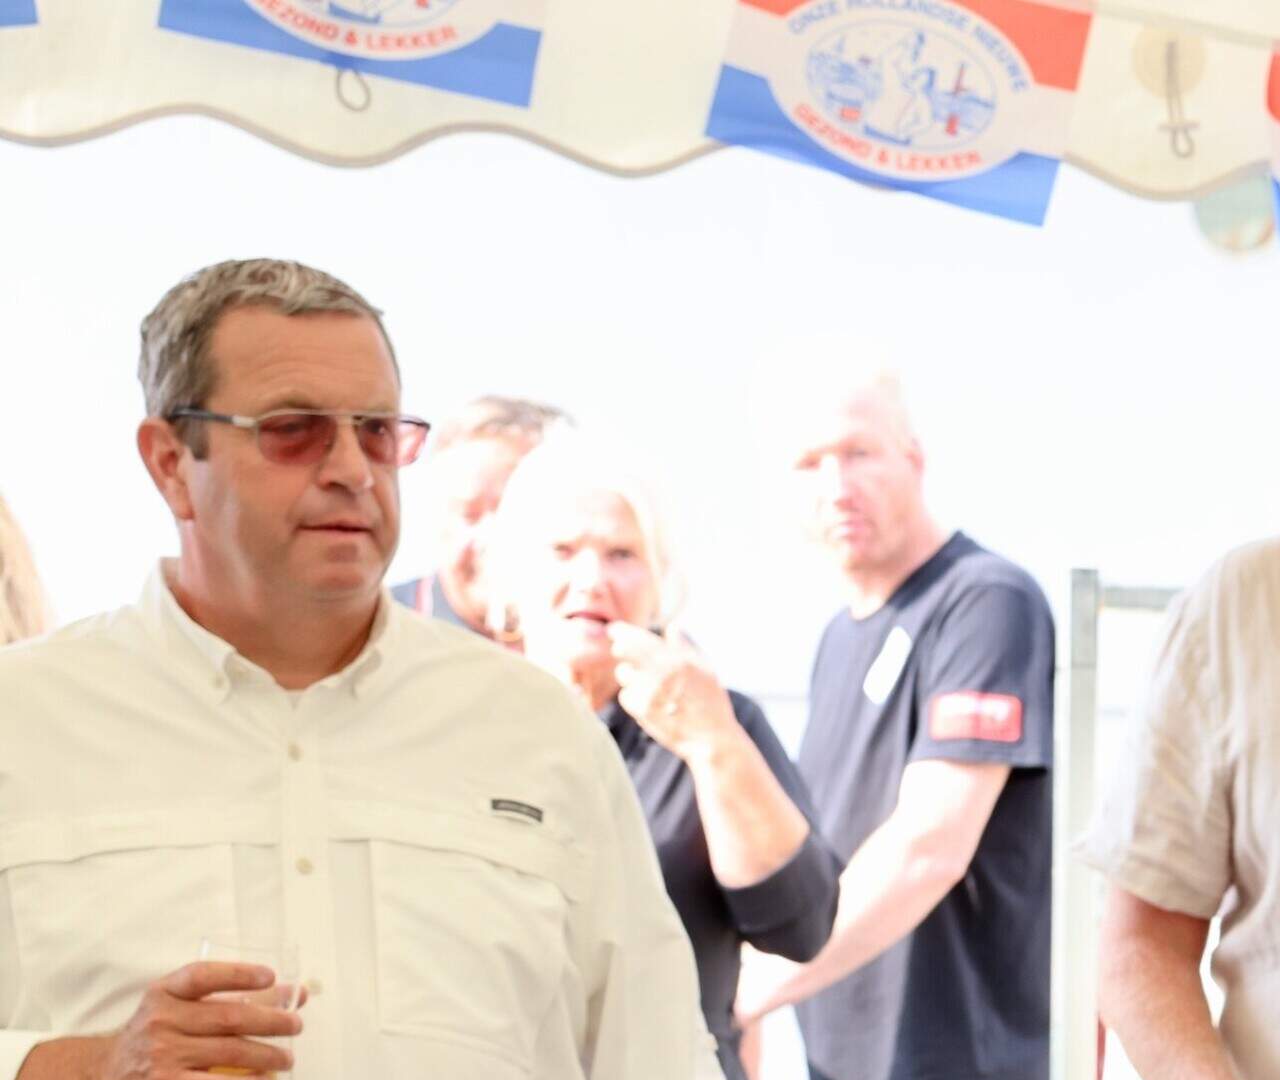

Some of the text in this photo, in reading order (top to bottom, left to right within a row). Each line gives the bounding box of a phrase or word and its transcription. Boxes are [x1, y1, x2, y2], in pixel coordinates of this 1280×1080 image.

[256, 0, 339, 40] EZOND
[365, 24, 457, 50] LEKKER
[793, 104, 872, 159] GEZOND
[896, 150, 981, 172] LEKKER
